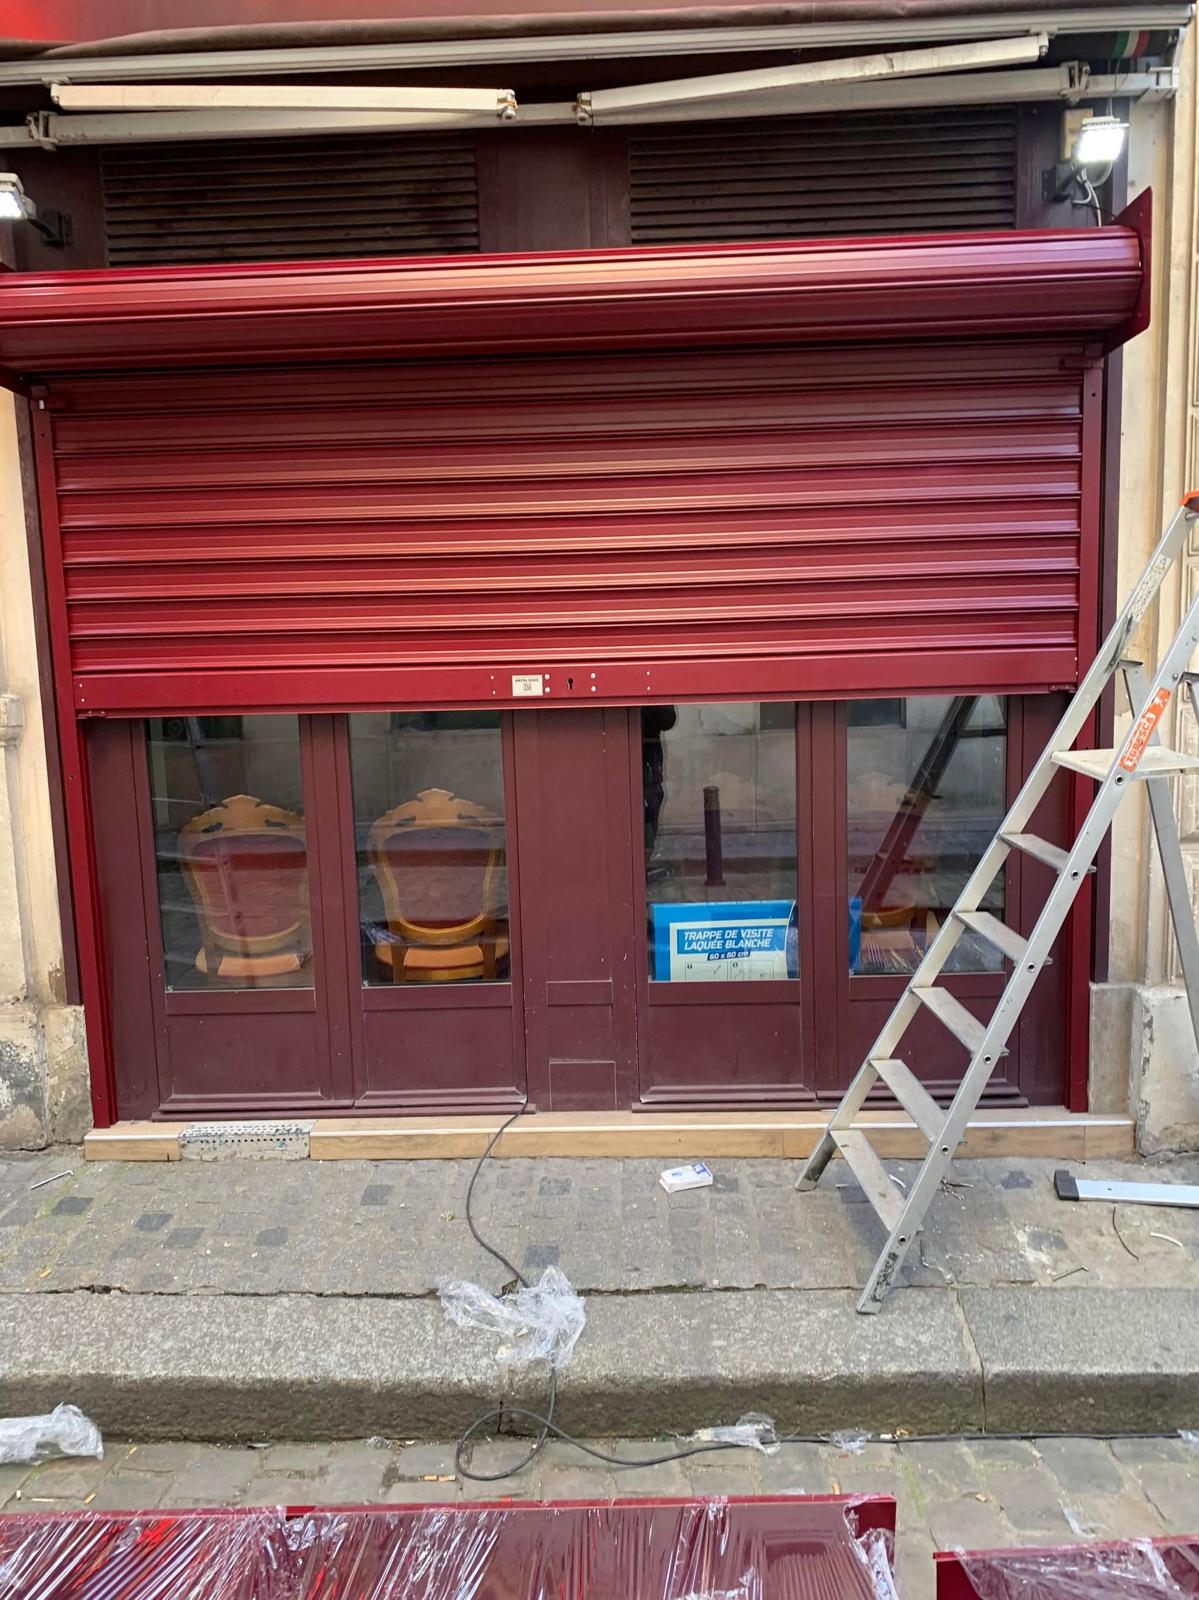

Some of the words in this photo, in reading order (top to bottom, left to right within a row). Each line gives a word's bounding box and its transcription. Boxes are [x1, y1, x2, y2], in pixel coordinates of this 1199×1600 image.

[684, 930, 723, 941] TRAPPE
[724, 929, 738, 939] DE
[741, 928, 774, 938] VISITE
[725, 938, 771, 949] BLANCHE
